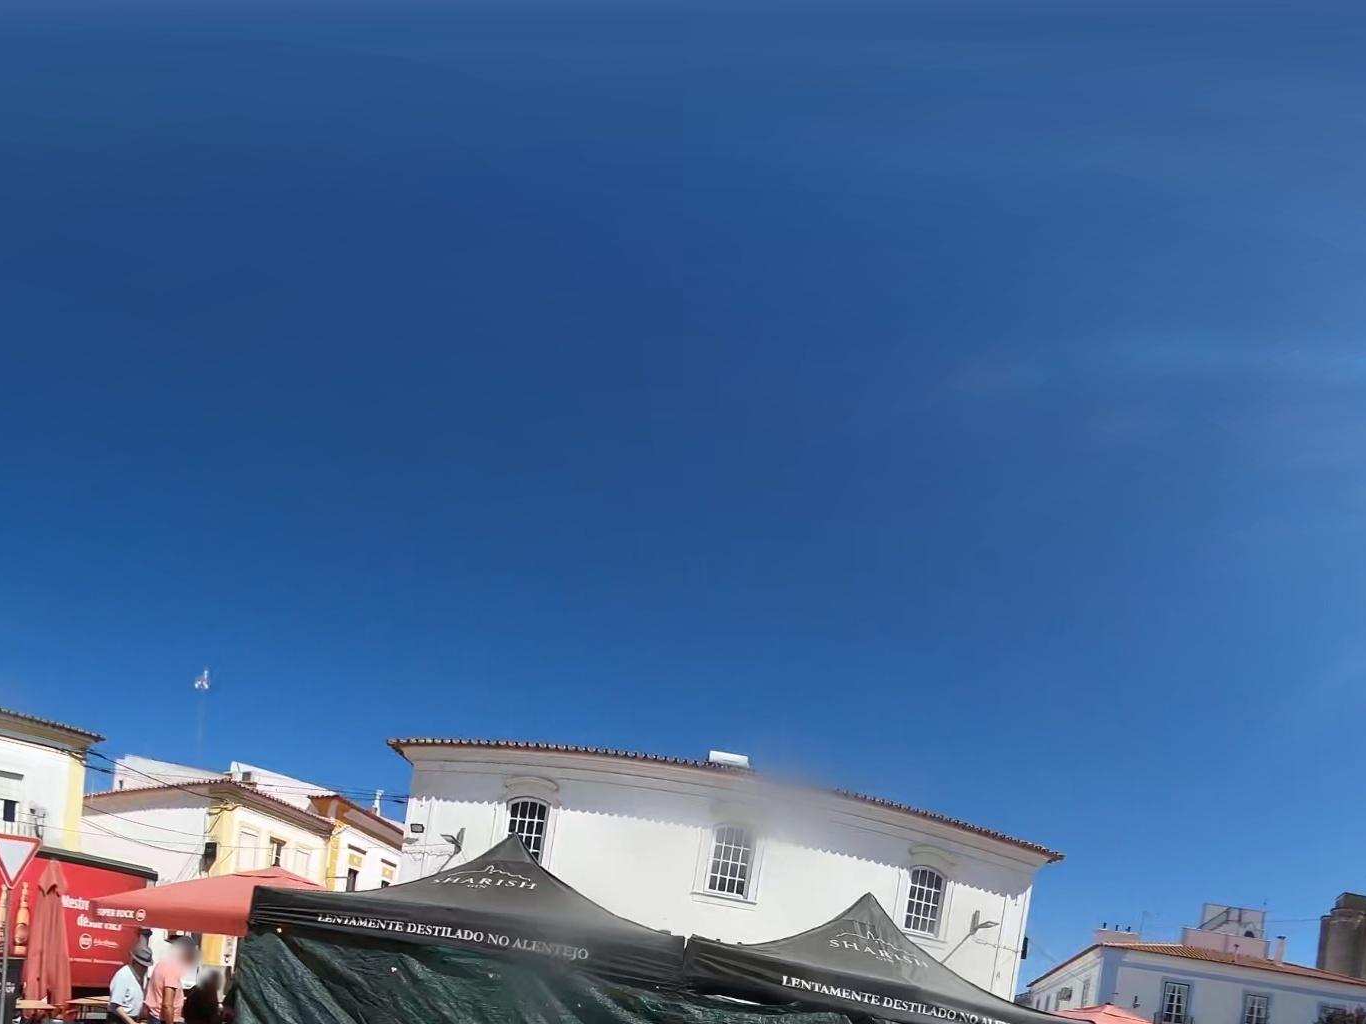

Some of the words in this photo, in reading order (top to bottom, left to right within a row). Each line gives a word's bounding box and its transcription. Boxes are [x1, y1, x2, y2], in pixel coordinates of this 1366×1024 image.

[317, 913, 404, 932] LENTAMENTE
[406, 922, 484, 943] DESTILADO
[487, 933, 510, 947] NO
[512, 937, 589, 961] ALENTEJO
[782, 975, 880, 1006] LENTAMENTE
[882, 996, 957, 1021] DESTILADO
[960, 1012, 979, 1024] NO
